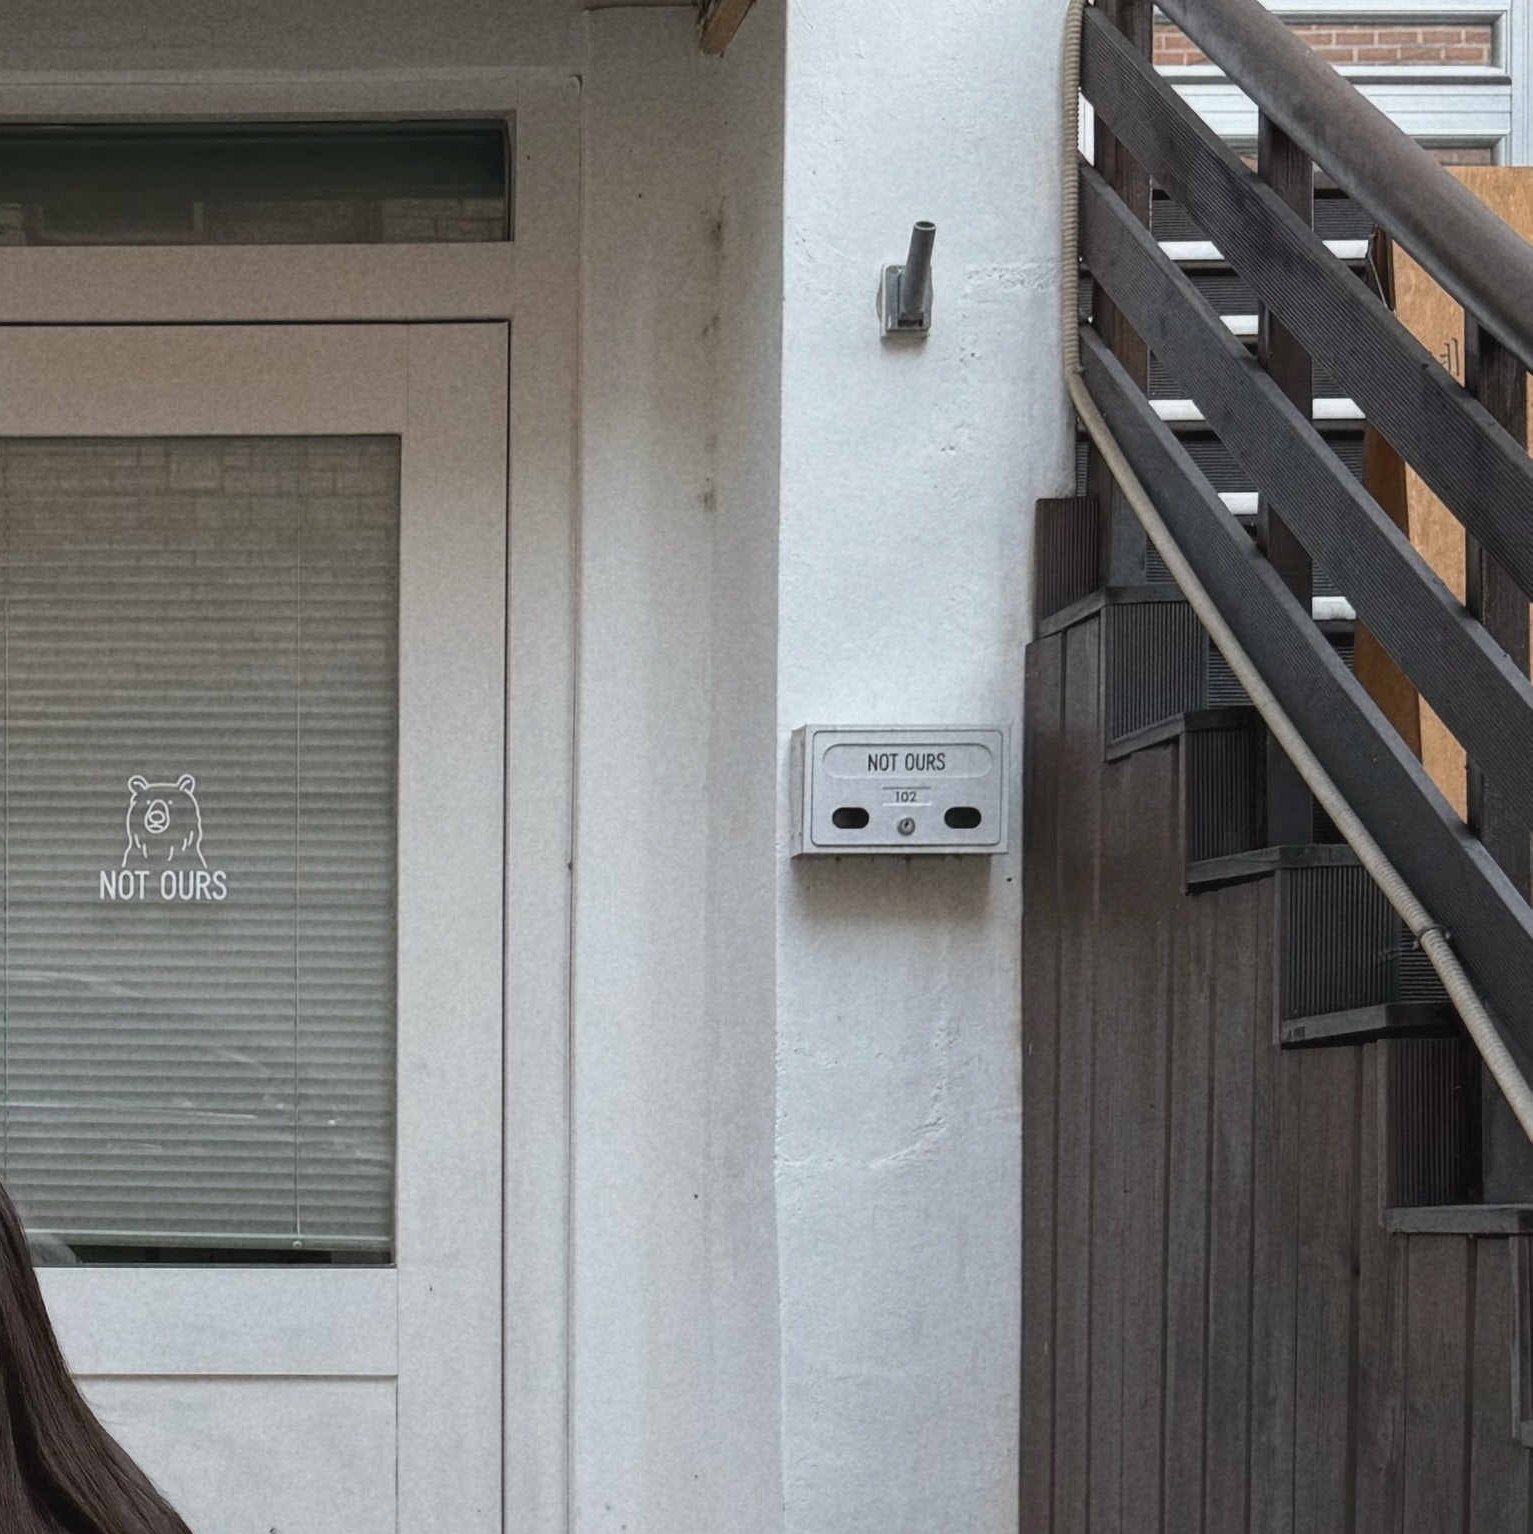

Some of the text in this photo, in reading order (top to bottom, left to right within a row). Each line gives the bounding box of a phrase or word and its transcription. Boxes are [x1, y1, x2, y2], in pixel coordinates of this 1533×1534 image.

[868, 752, 945, 771] NOT OURS
[895, 791, 917, 803] 102
[99, 870, 227, 900] NOT OURS
